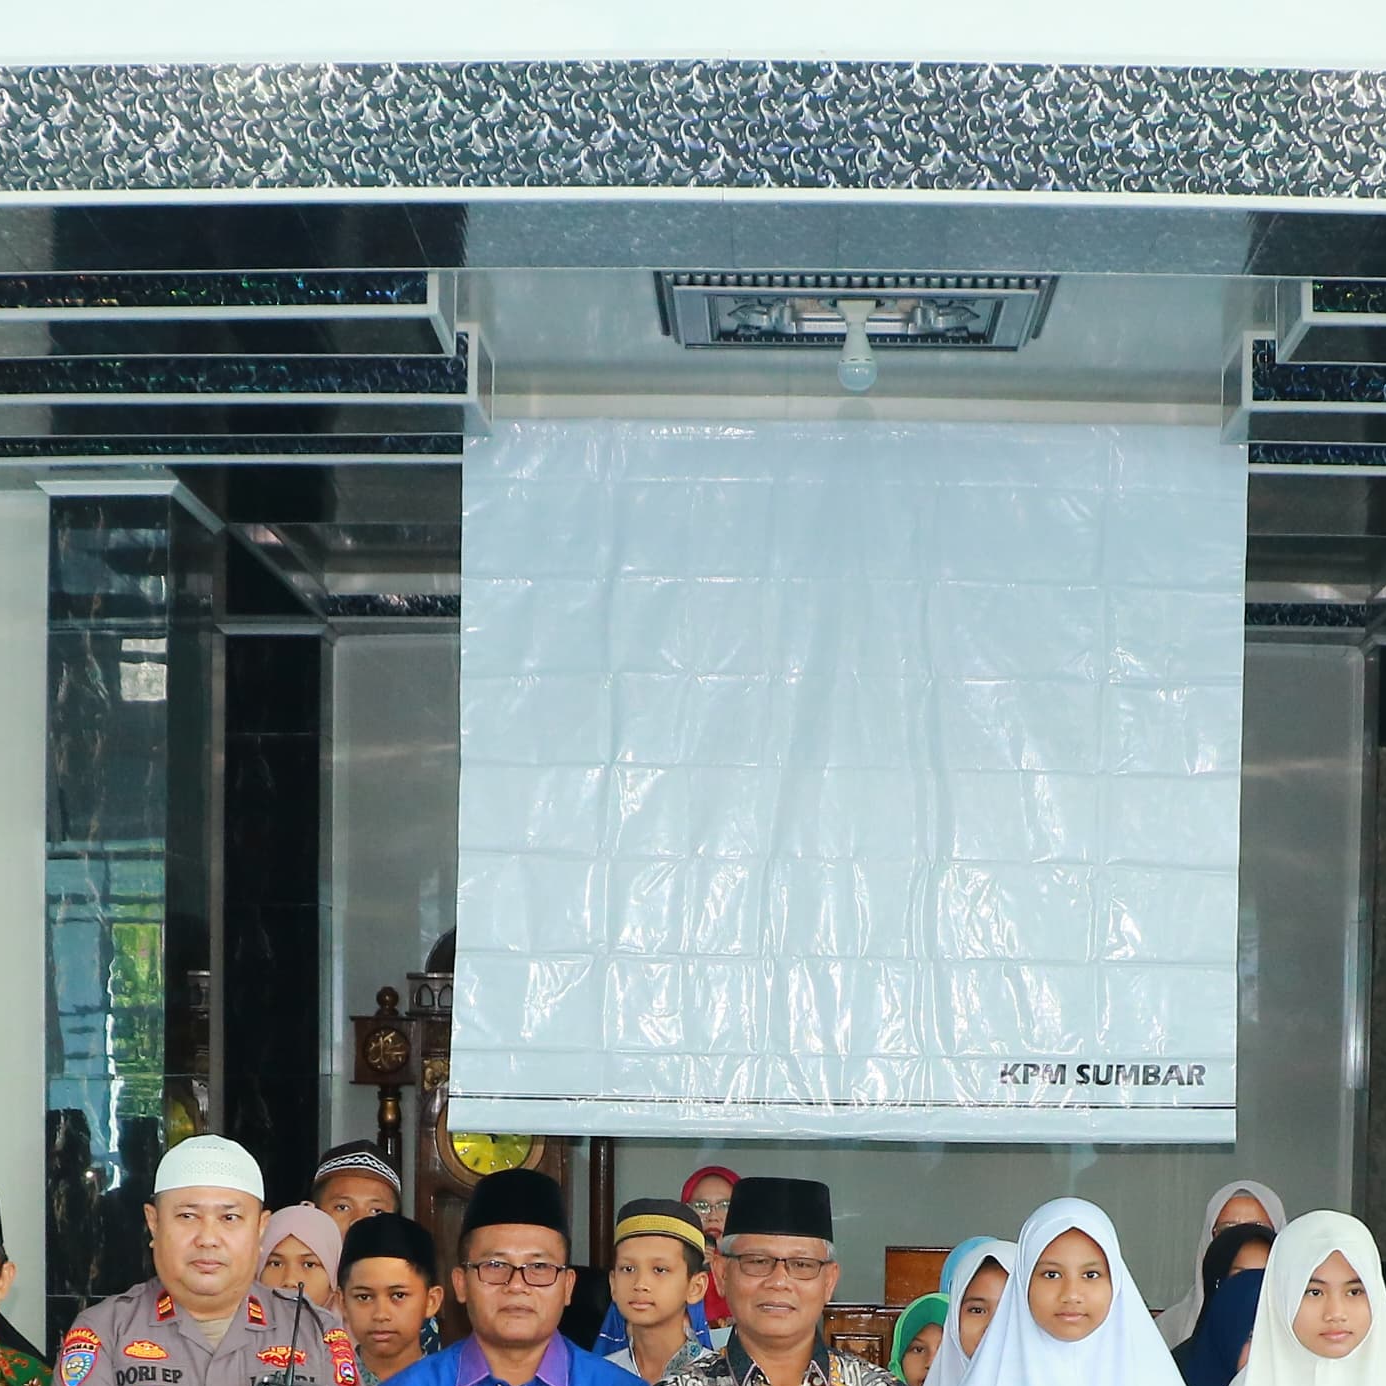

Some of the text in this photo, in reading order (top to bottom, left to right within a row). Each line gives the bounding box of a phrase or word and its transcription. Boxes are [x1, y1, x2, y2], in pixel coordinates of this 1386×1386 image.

[1000, 1063, 1206, 1087] KPM SUMBAR
[161, 1368, 183, 1384] EP
